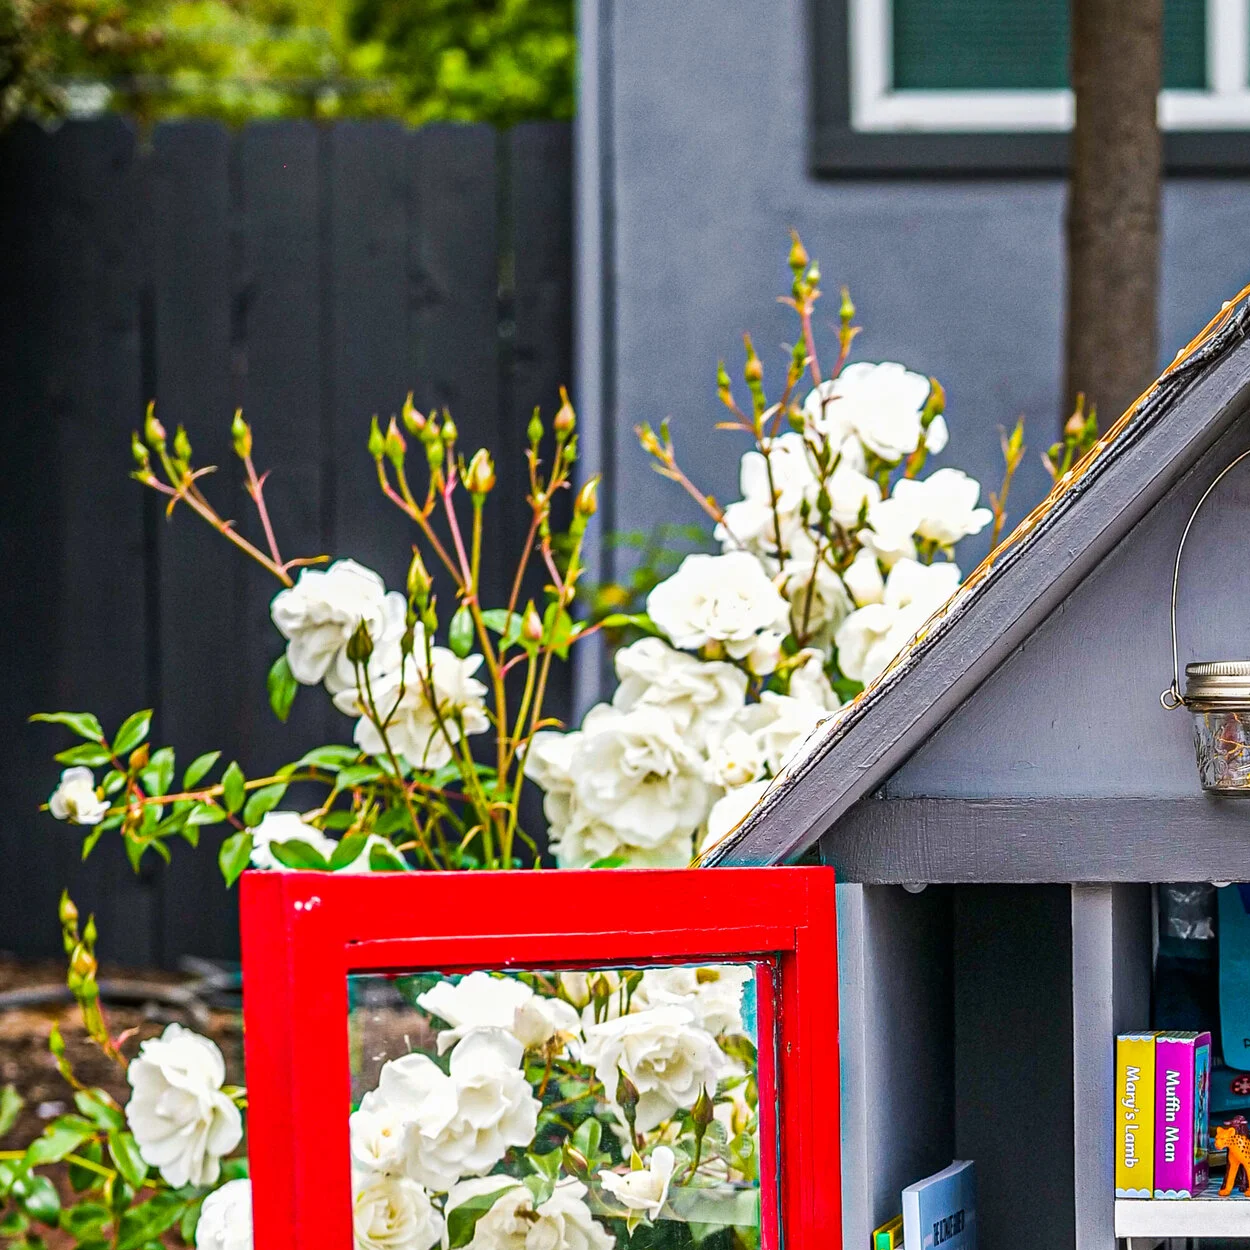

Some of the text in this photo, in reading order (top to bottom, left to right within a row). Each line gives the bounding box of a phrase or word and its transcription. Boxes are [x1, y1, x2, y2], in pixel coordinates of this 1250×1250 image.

[1121, 1065, 1141, 1168] Mary's Lamb
[1164, 1069, 1181, 1163] Muffin Man
